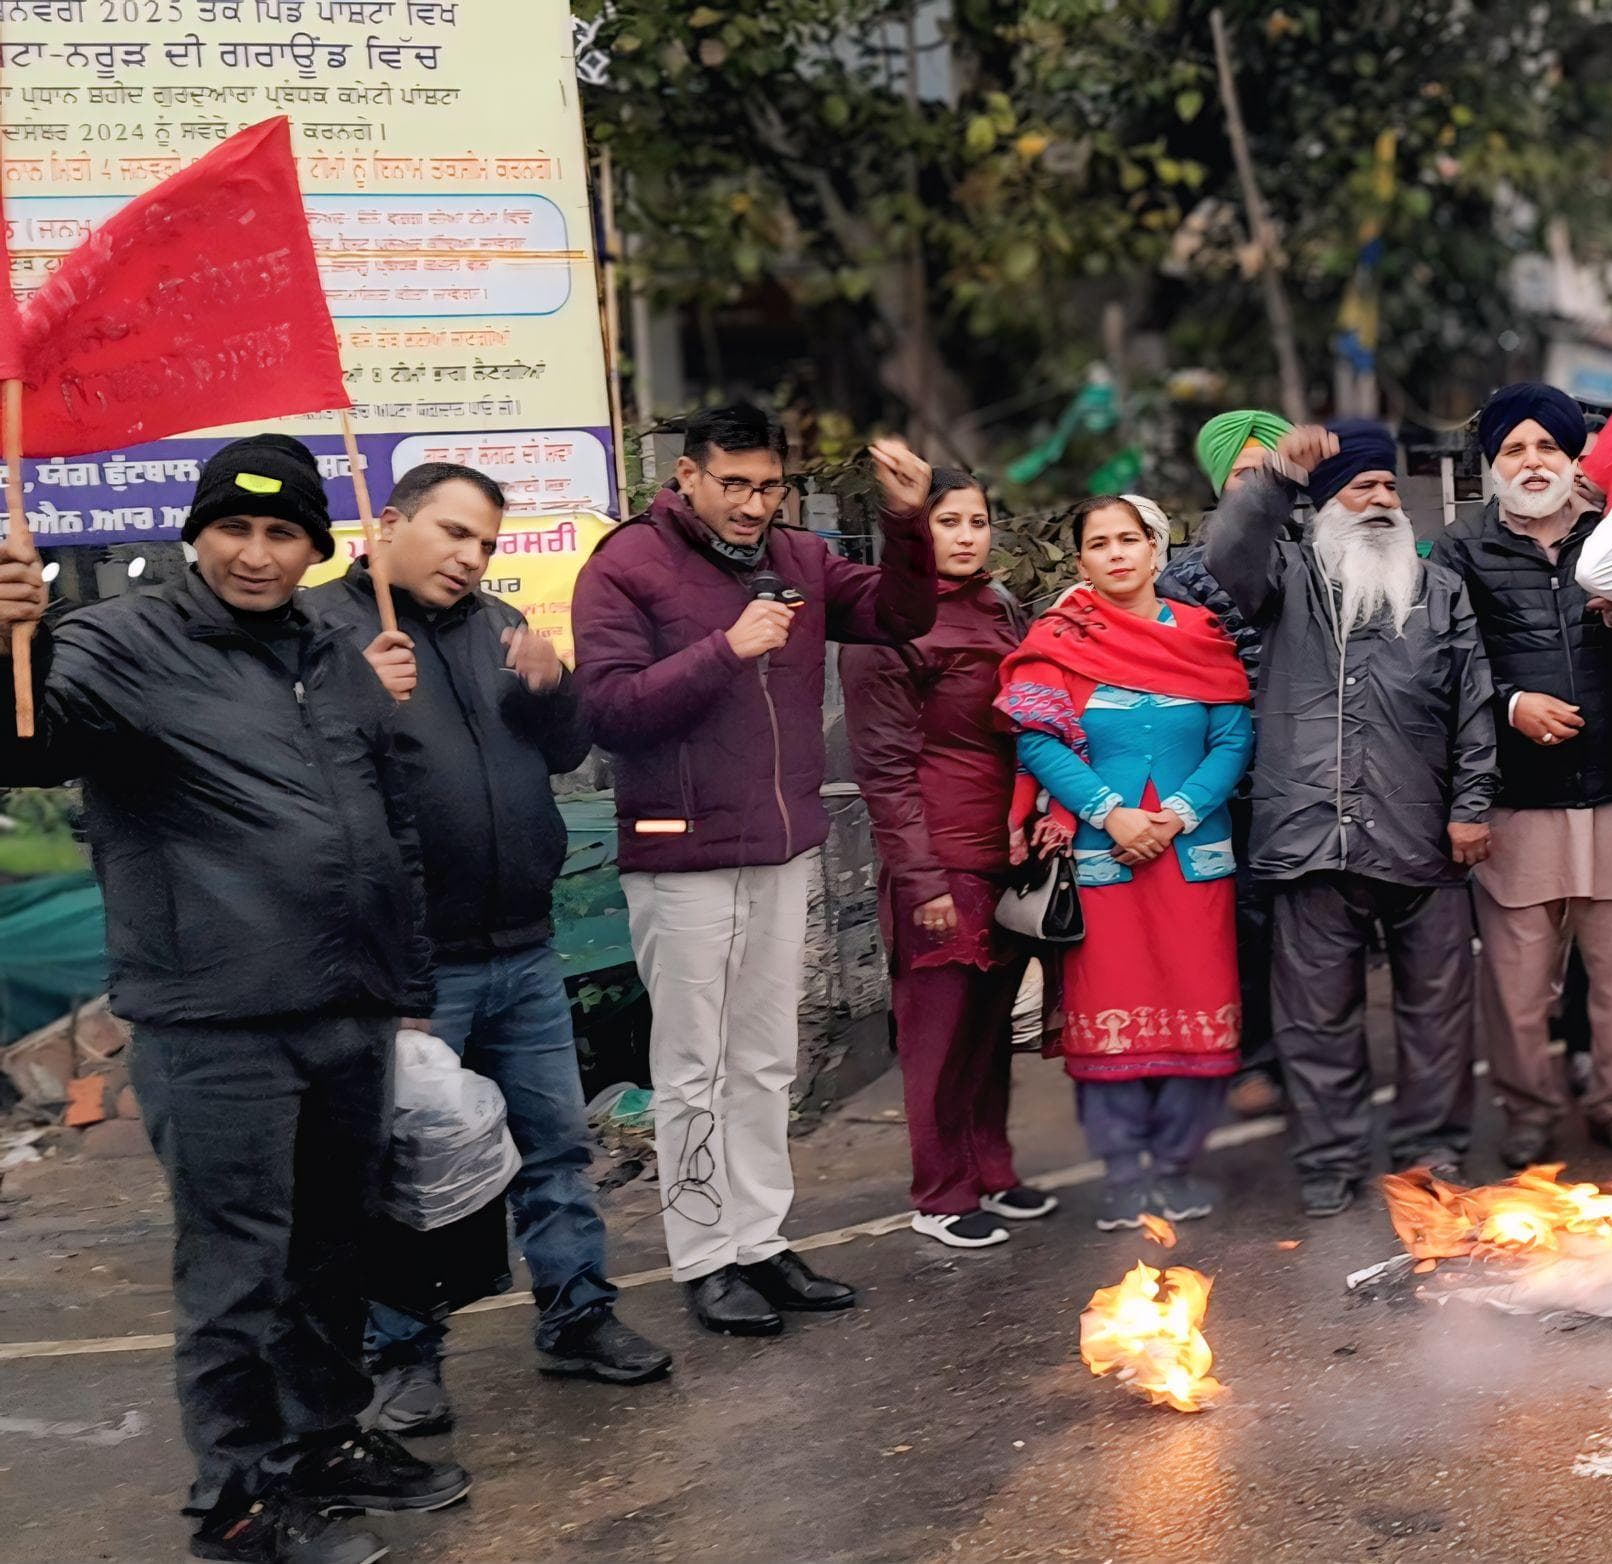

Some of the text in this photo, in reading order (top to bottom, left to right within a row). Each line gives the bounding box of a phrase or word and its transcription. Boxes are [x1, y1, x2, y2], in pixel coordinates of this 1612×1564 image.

[164, 33, 206, 68] ਦੀ
[366, 35, 442, 69] ਵਿੱਚ
[79, 123, 145, 141] 2024
